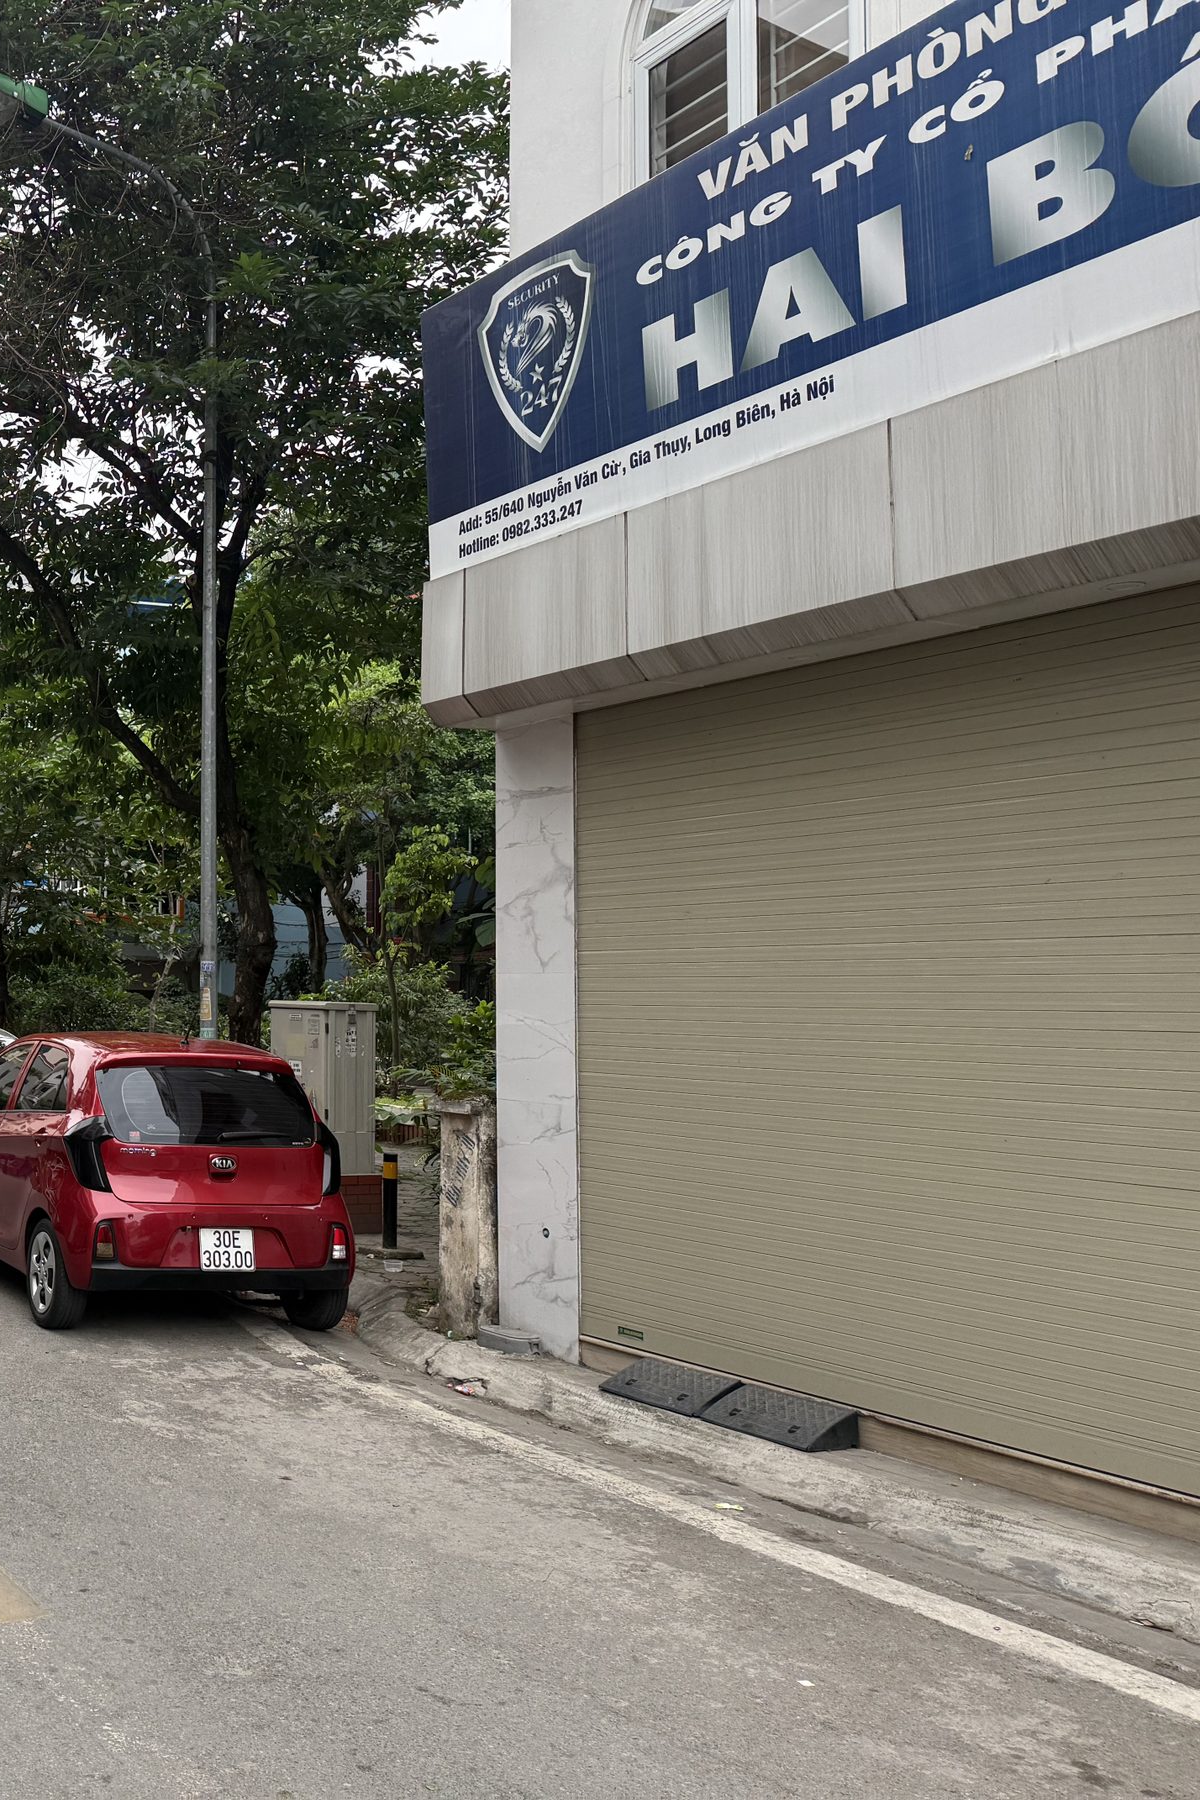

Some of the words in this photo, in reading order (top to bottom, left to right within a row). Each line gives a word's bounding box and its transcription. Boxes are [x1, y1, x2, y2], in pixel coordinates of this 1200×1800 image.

[635, 190, 793, 285] CÔNG
[811, 134, 888, 195] TY
[908, 68, 1005, 144] CỔ
[697, 113, 809, 201] VĂN
[507, 272, 561, 311] SECURITY
[641, 204, 908, 412] HAI
[520, 375, 563, 417] 247
[458, 514, 483, 536] Add:
[484, 497, 524, 526] 55/640
[527, 476, 572, 509] Nguyễn
[574, 470, 598, 490] Văn
[629, 449, 651, 469] Gia
[653, 435, 691, 457] Thụy,
[695, 418, 731, 445] Long
[735, 403, 776, 429] Biên,
[779, 388, 801, 412] Hà
[806, 374, 835, 401] Nội
[458, 532, 500, 559] Hotline:
[502, 499, 584, 542] 0982.333.247
[214, 1158, 233, 1169] KIA
[202, 1250, 253, 1269] 303.00
[212, 1230, 241, 1249] 30E
